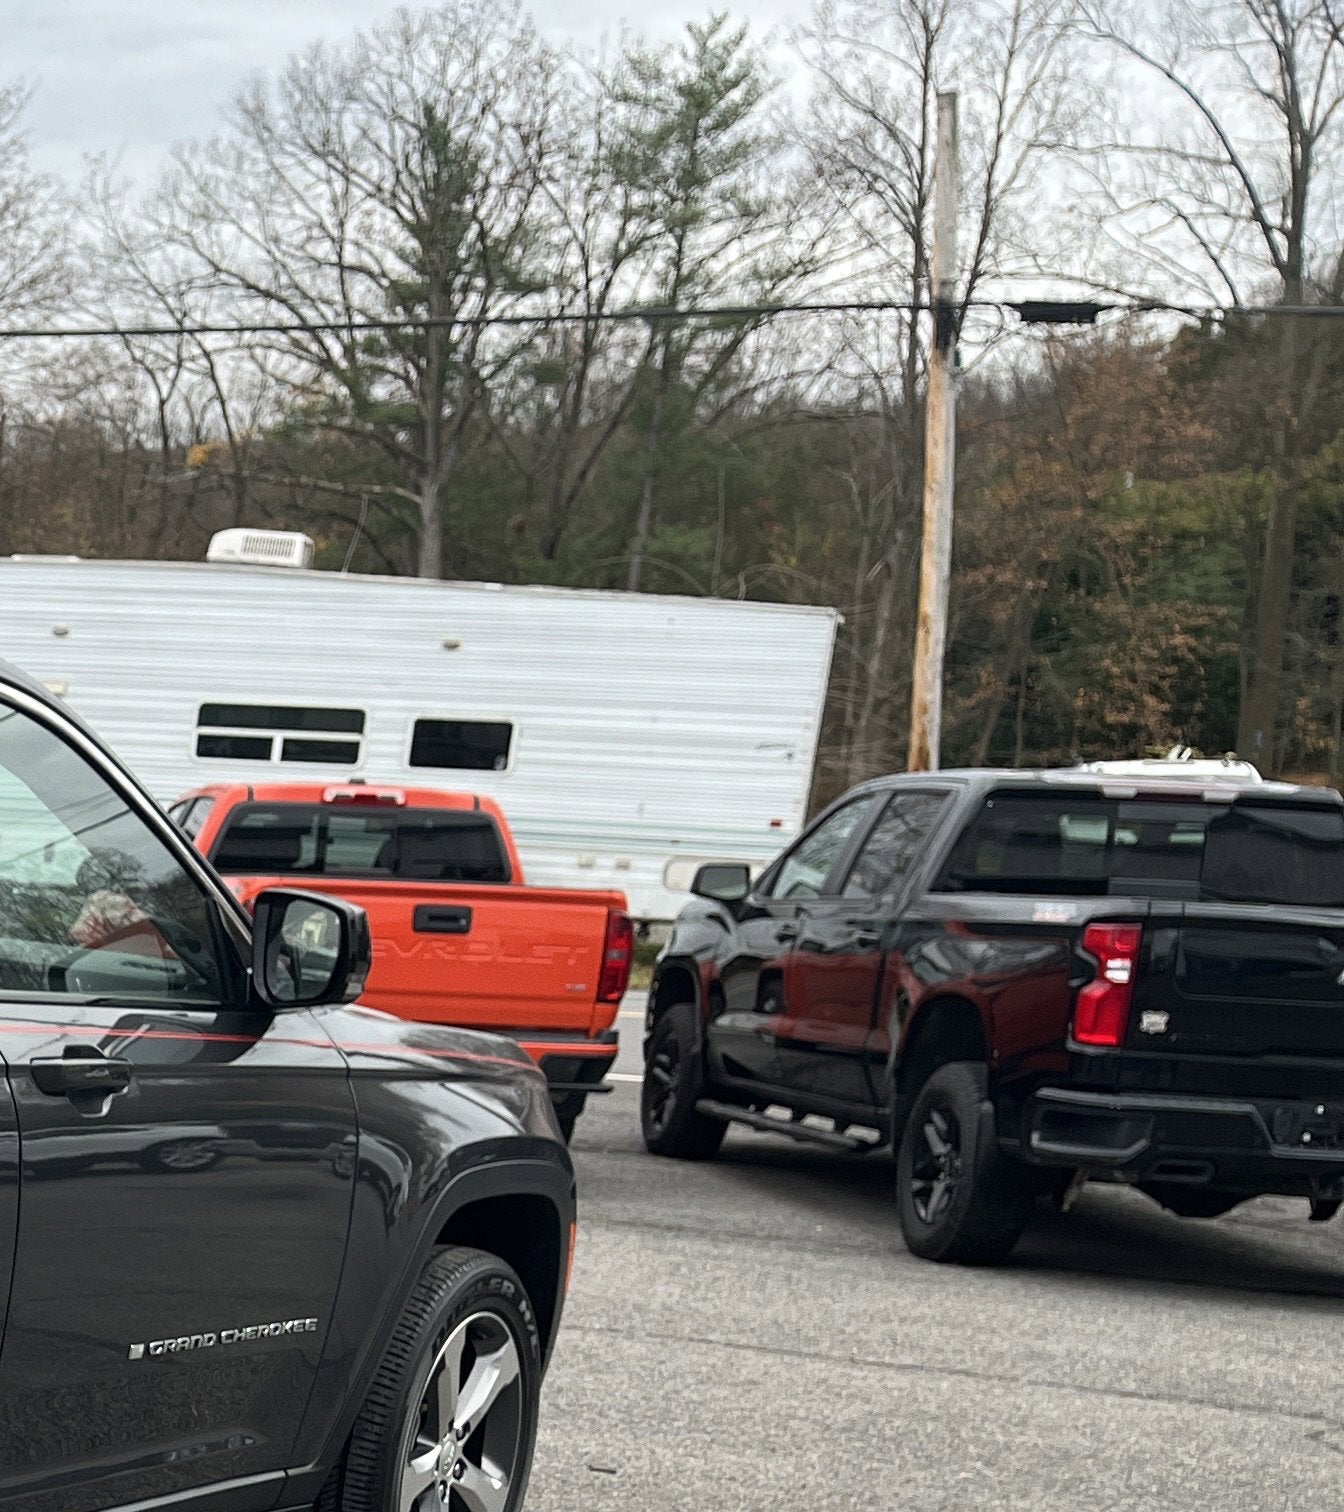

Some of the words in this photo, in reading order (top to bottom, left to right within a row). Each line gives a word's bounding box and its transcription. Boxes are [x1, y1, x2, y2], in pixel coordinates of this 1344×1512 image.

[371, 938, 589, 966] EVROLET
[149, 1332, 216, 1357] GRAND
[219, 1317, 318, 1344] CHEROKEE
